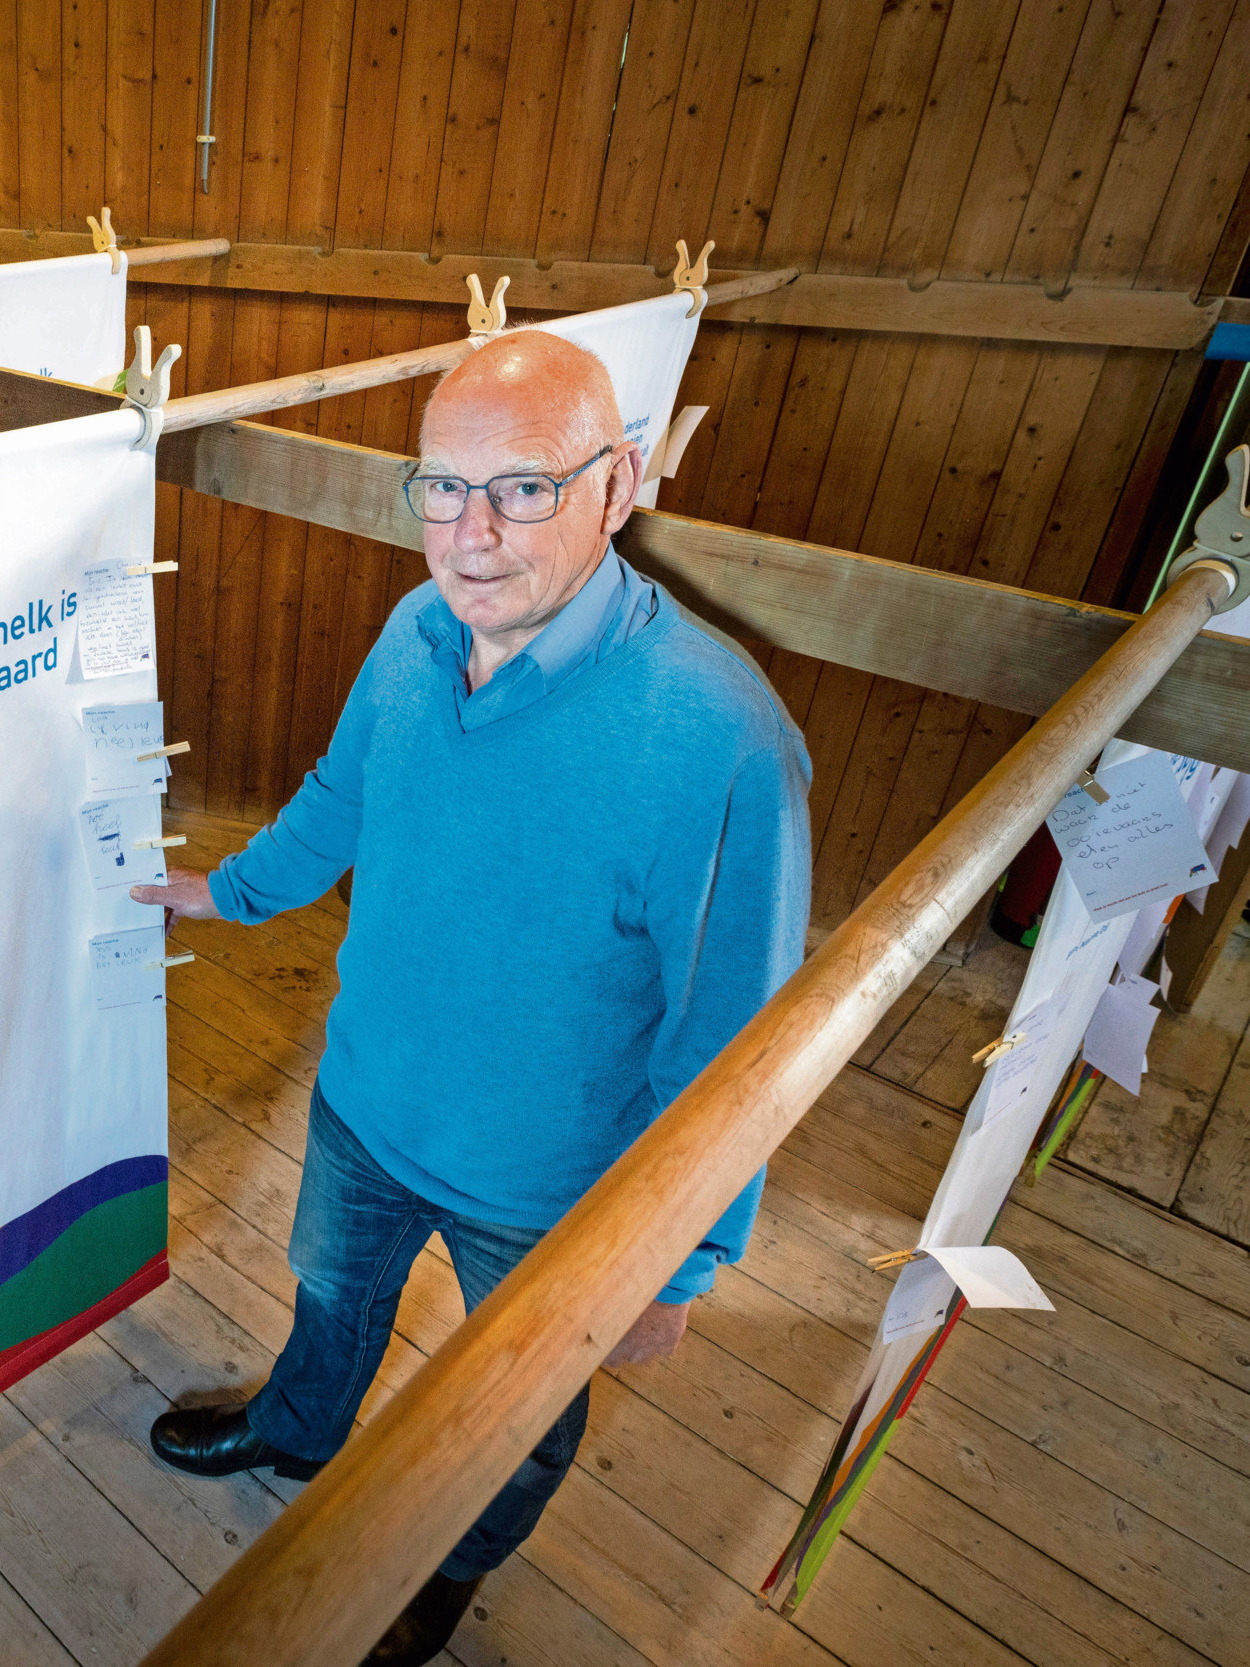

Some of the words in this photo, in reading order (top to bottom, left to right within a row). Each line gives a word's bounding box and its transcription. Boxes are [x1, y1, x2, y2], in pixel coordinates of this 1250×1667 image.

[58, 588, 78, 622] is
[1052, 804, 1087, 823] Dat
[1111, 802, 1131, 813] de
[1076, 843, 1119, 859] eten
[1127, 822, 1174, 843] alles
[1092, 856, 1120, 870] op
